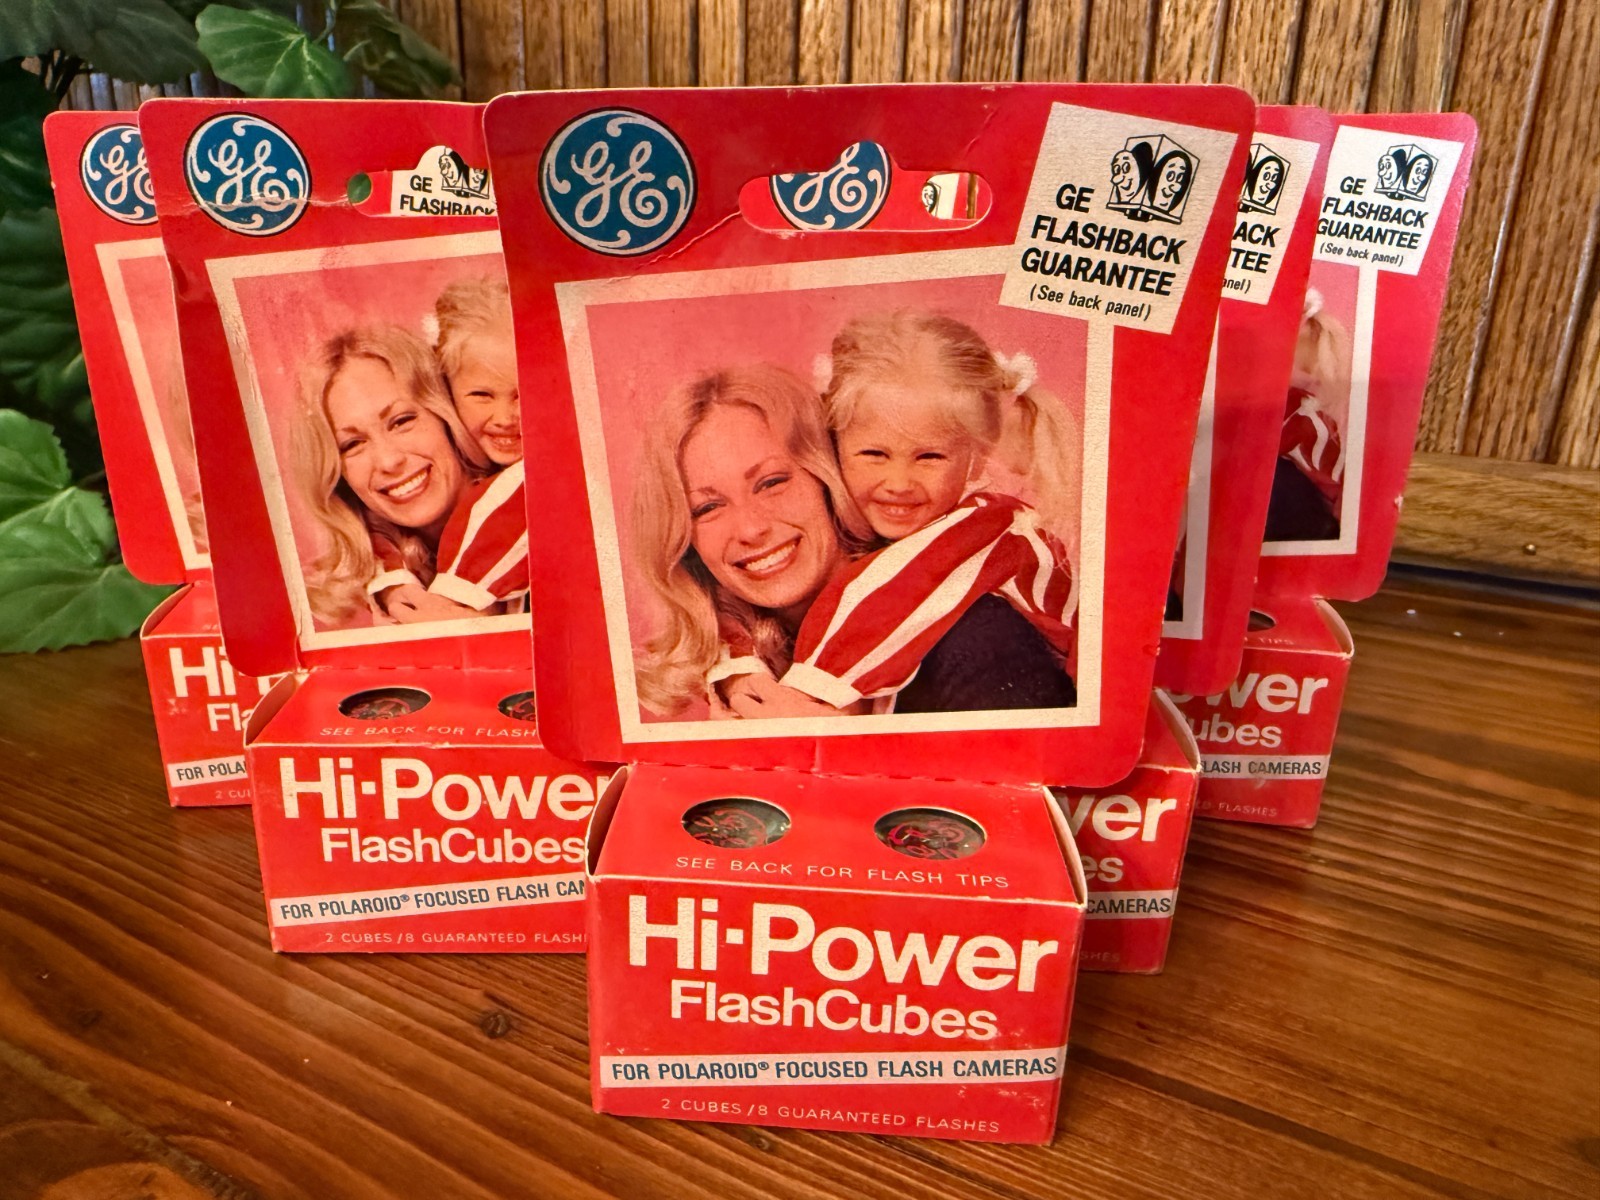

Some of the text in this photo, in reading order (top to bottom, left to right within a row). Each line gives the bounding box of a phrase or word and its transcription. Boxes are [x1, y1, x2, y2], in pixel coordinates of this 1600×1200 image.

[410, 175, 432, 193] GE
[1056, 183, 1095, 214] GE
[1340, 176, 1366, 195] GE
[1322, 197, 1429, 229] FLASHBACK
[1031, 214, 1187, 264] FLASHBACK
[1316, 218, 1422, 249] GUARANTEE
[1320, 242, 1404, 267] (See back panel)
[1021, 247, 1176, 296] GUARANTEE
[1029, 283, 1152, 322] (See back panel)
[320, 726, 537, 737] SEE BACK FOR FLASH
[176, 761, 247, 781] FOR POLA
[1248, 761, 1321, 775] CAMERAS
[1219, 802, 1277, 817] FLASHES
[321, 828, 587, 864] FlashCubes
[676, 856, 1009, 888] SEE BACK FOR FLASH TIPS
[280, 903, 313, 919] FOR
[414, 888, 490, 909] FOCUSED
[498, 883, 550, 902] FLASH
[1087, 897, 1171, 914] CAMERAS
[325, 933, 333, 943] 2
[422, 933, 526, 943] GUARANTEED
[670, 979, 998, 1041] FlashCubes
[612, 1063, 650, 1080] FOR
[775, 1060, 868, 1079] FOCUSED
[878, 1060, 943, 1078] FLASH
[953, 1056, 1057, 1077] CAMERAS
[661, 1098, 670, 1110] 2
[778, 1106, 906, 1126] GUARANTEED
[916, 1116, 999, 1133] FLASHES
